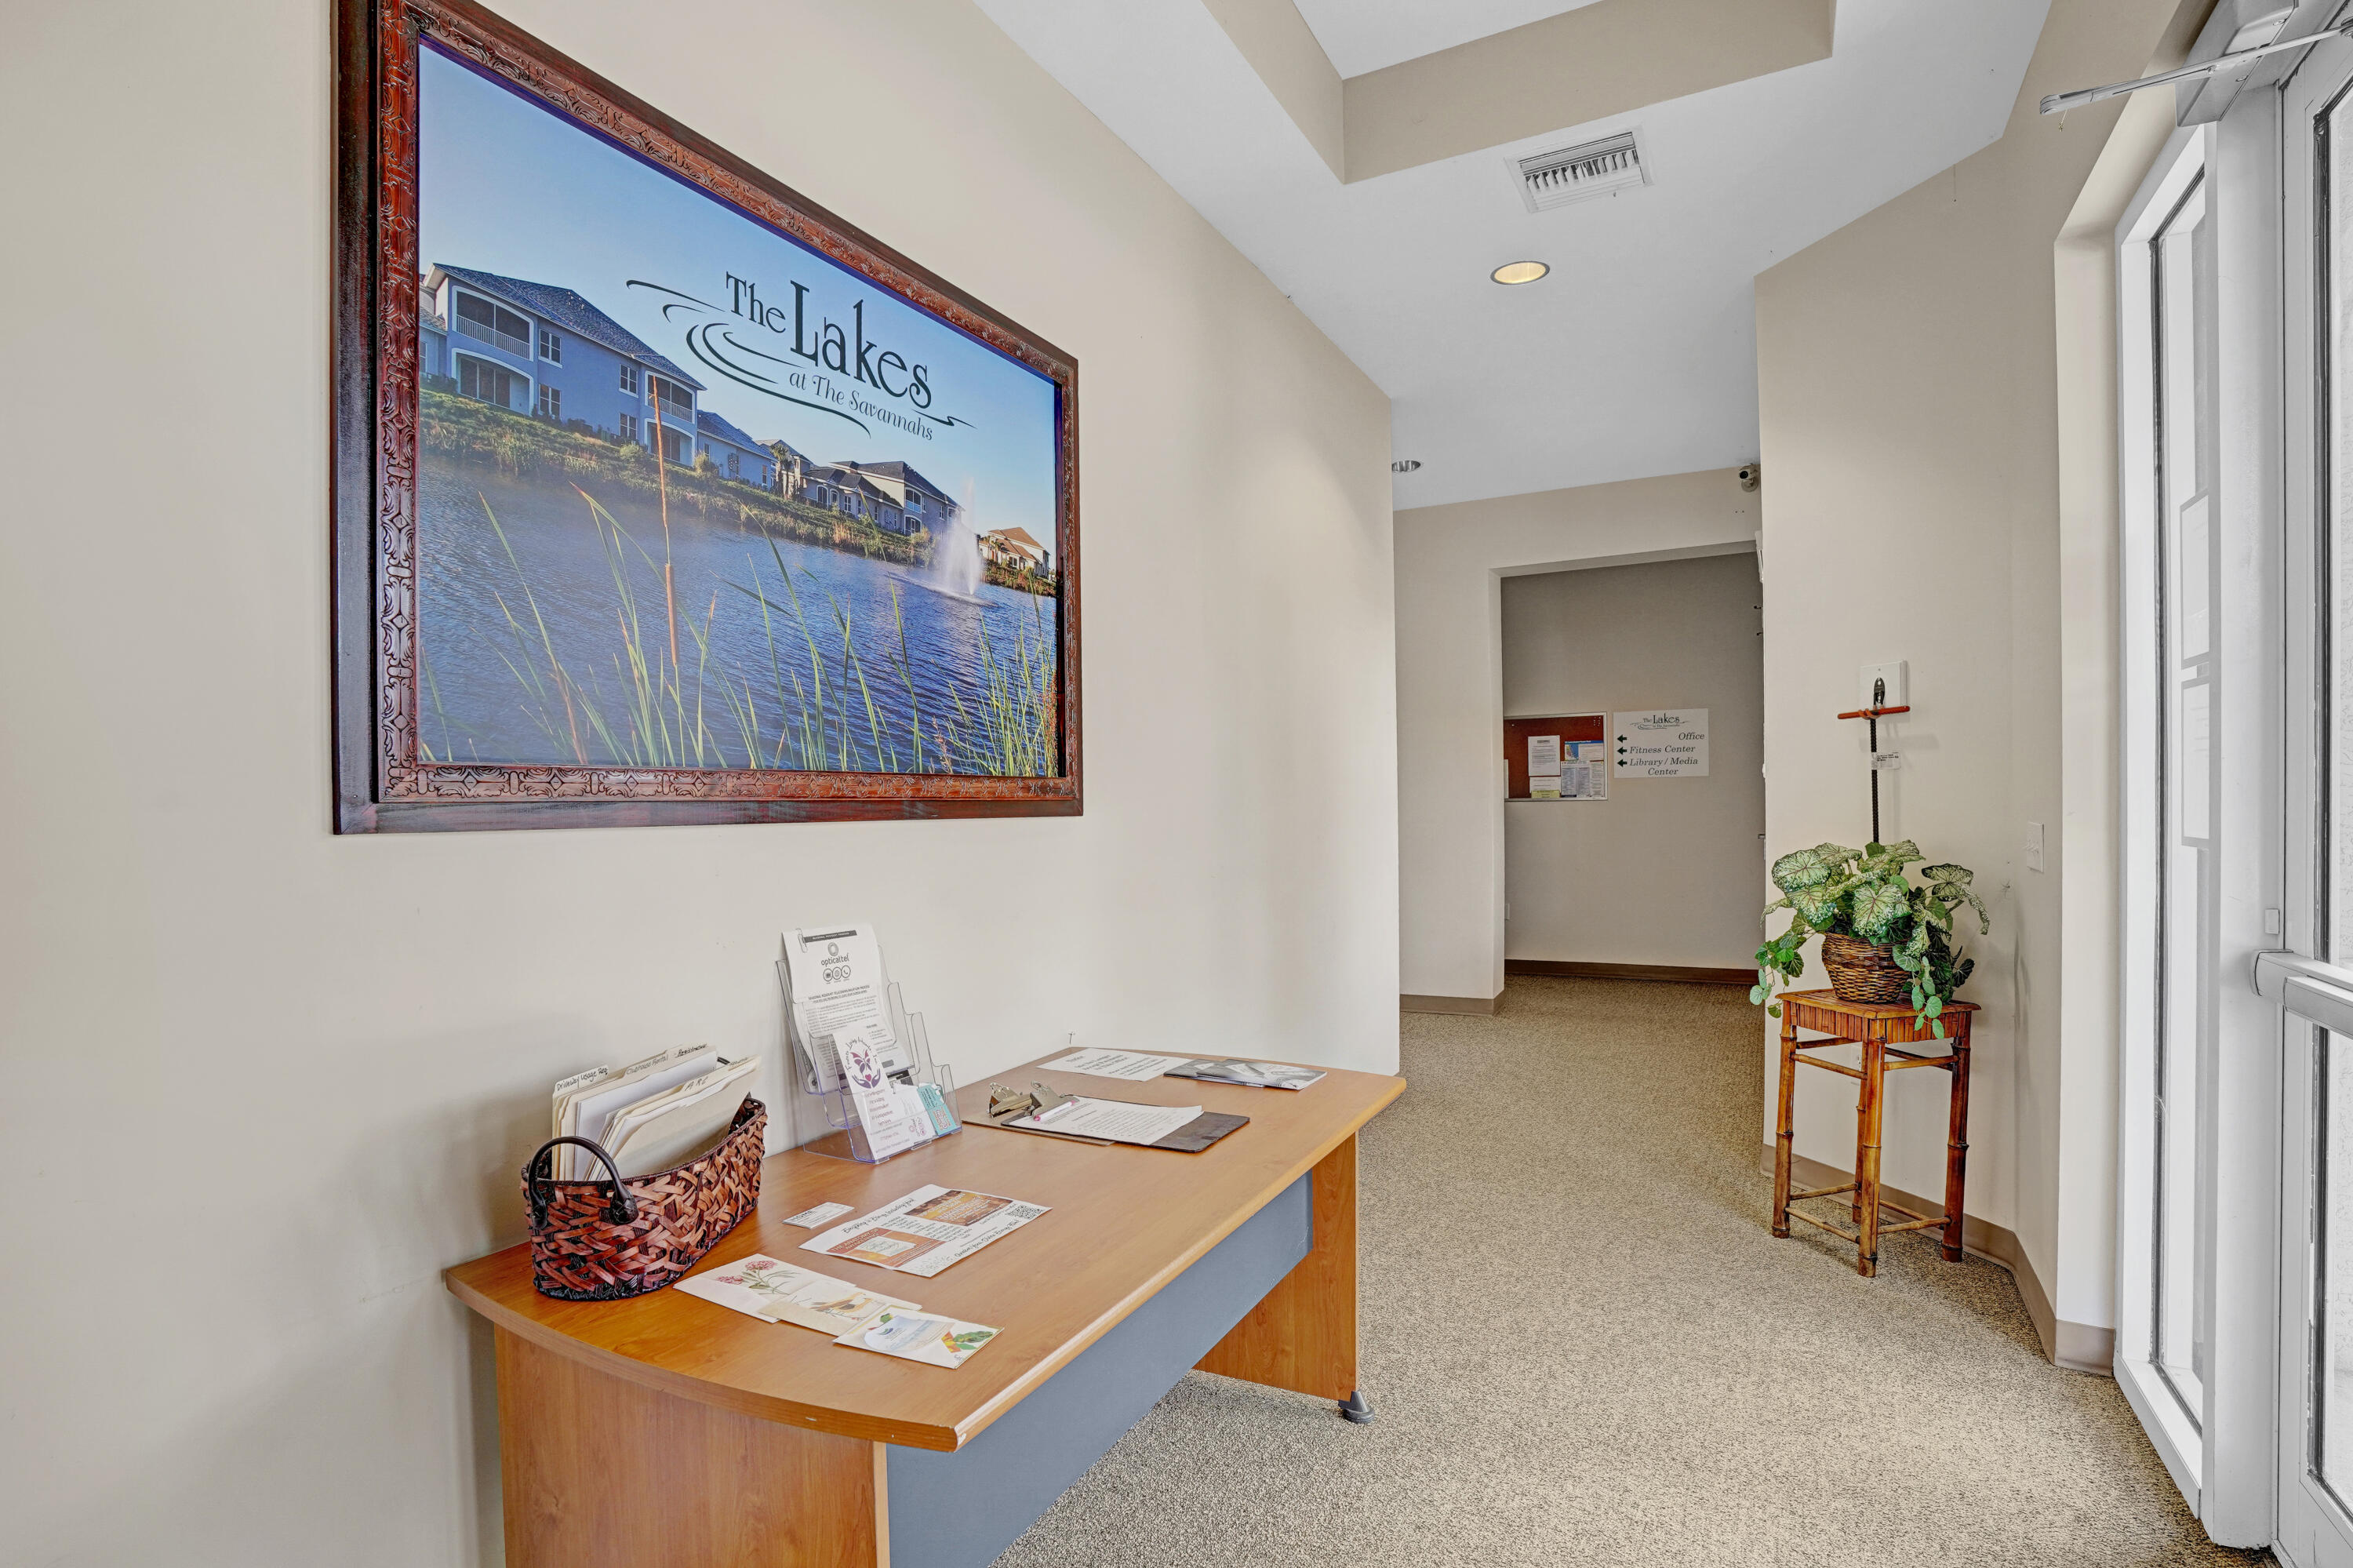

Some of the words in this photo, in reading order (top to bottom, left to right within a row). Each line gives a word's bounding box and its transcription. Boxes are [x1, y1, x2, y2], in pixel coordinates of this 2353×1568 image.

[726, 271, 786, 333] The
[790, 279, 933, 409] Lakes
[789, 369, 806, 391] at
[813, 374, 845, 406] The
[849, 390, 933, 441] Savannahs
[1653, 713, 1680, 724] Lakes
[1678, 732, 1705, 740] Office
[1629, 758, 1663, 767] Library
[1648, 767, 1679, 776] Center
[820, 952, 849, 966] opticaltel
[627, 1061, 651, 1075] Clubhouse
[652, 1054, 669, 1067] Rental
[557, 1075, 580, 1091] Driveway
[580, 1071, 597, 1082] Usage
